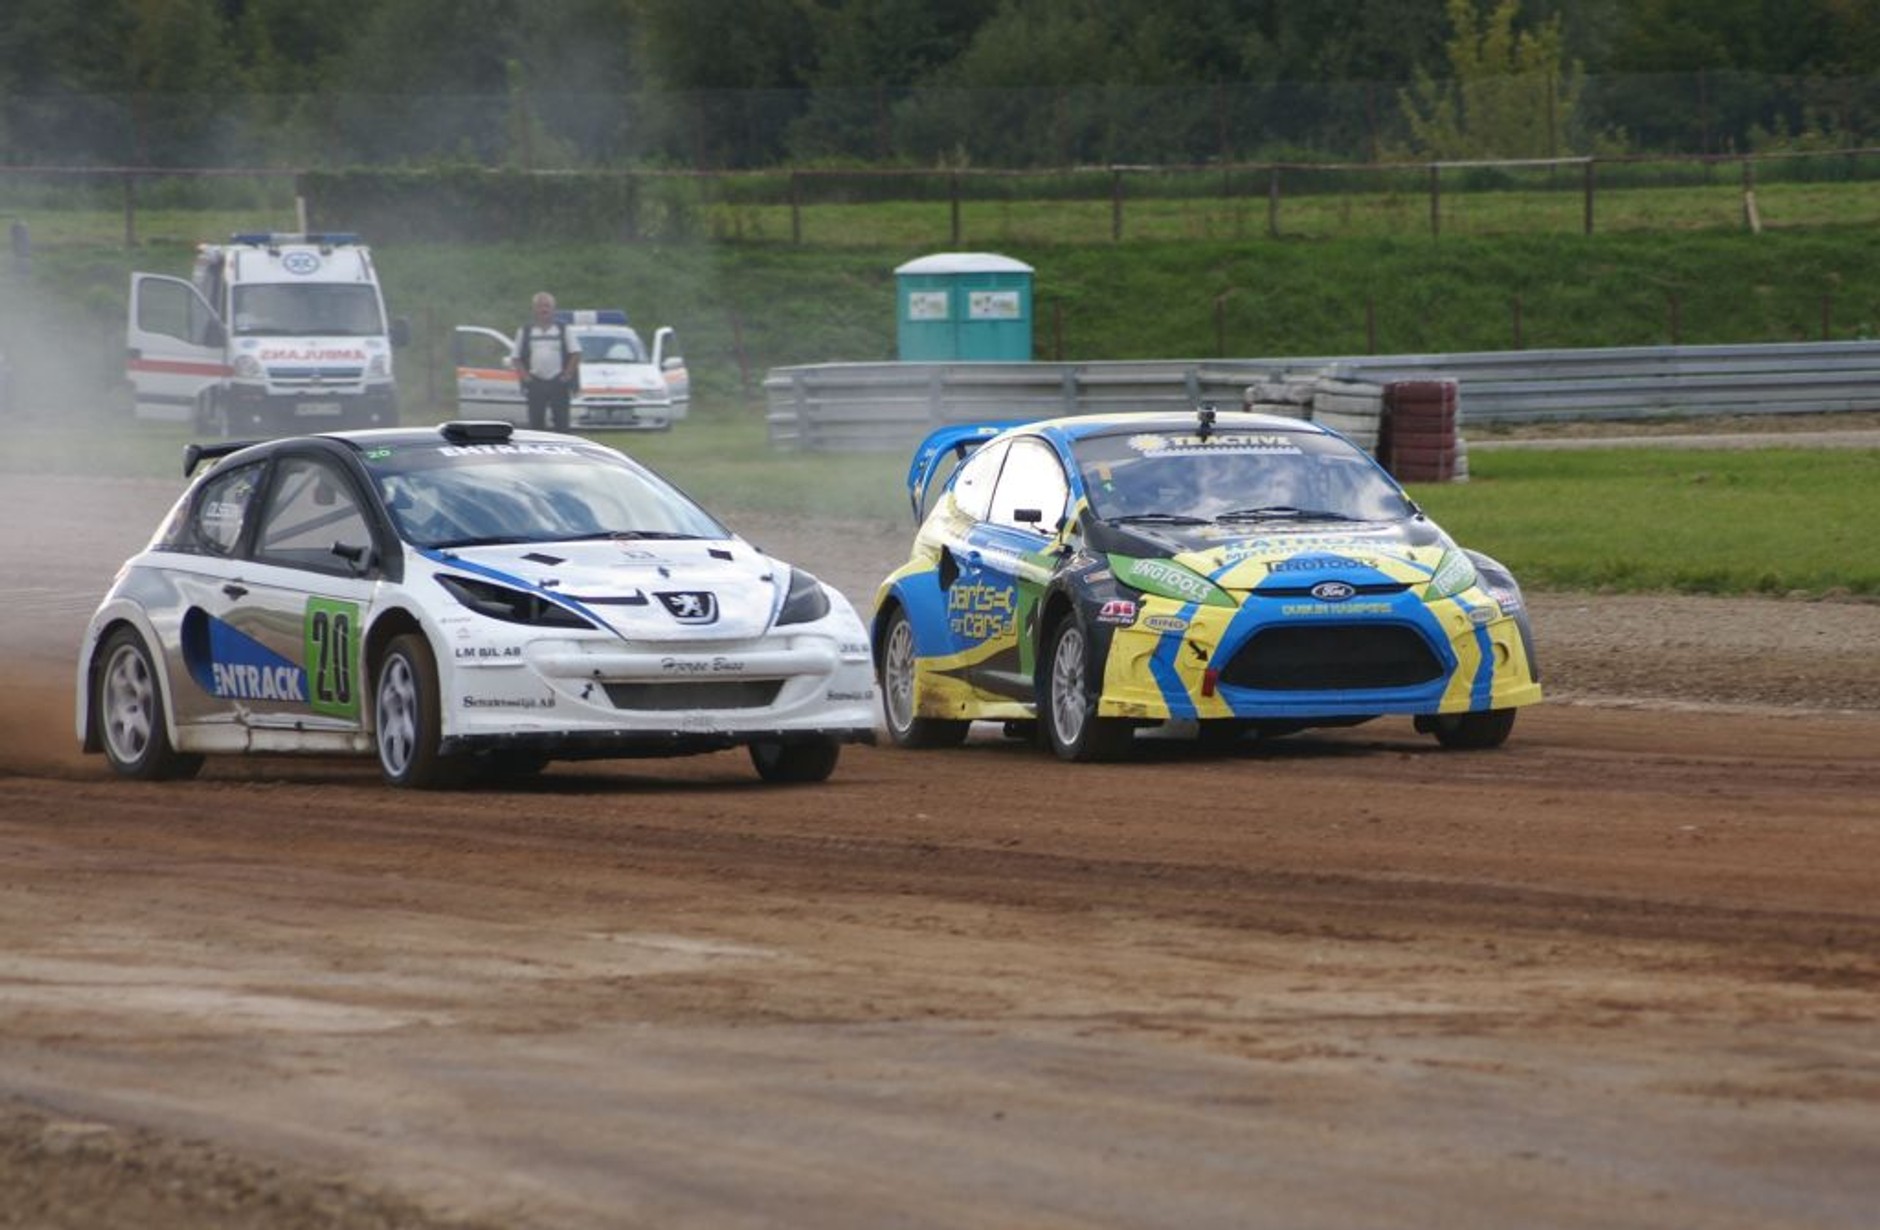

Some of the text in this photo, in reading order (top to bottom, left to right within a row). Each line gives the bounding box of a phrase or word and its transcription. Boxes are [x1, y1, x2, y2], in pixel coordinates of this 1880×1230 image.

[1321, 585, 1347, 598] Ford
[312, 610, 351, 704] 20
[211, 662, 303, 701] ENTRACK
